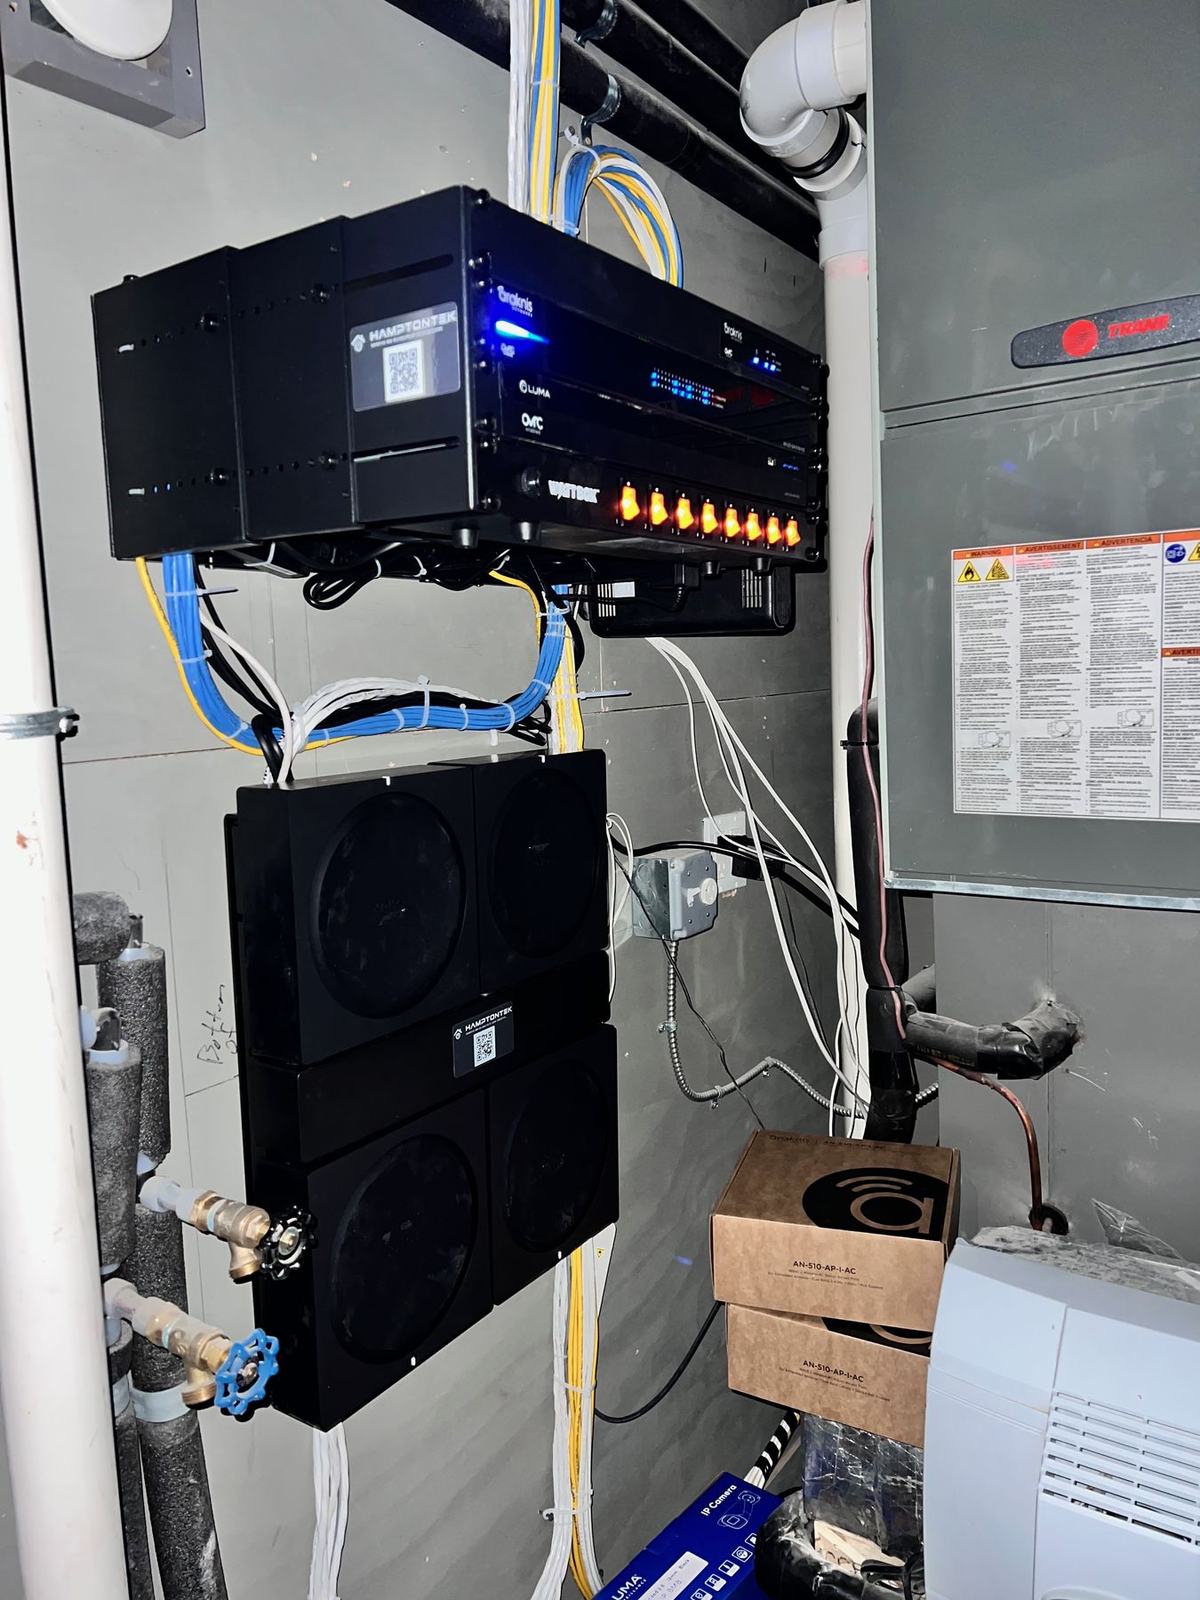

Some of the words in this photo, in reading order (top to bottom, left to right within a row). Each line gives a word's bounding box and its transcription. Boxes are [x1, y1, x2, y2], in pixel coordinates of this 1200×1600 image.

[369, 310, 456, 341] HAMPTONTEK
[527, 384, 551, 399] LUMA
[1025, 542, 1081, 552] AVERTISSEMENT
[1101, 536, 1153, 547] ADVERTENCIA
[465, 1006, 512, 1032] HAMPTONTEK
[701, 1507, 711, 1517] IP
[708, 1484, 737, 1509] Camera
